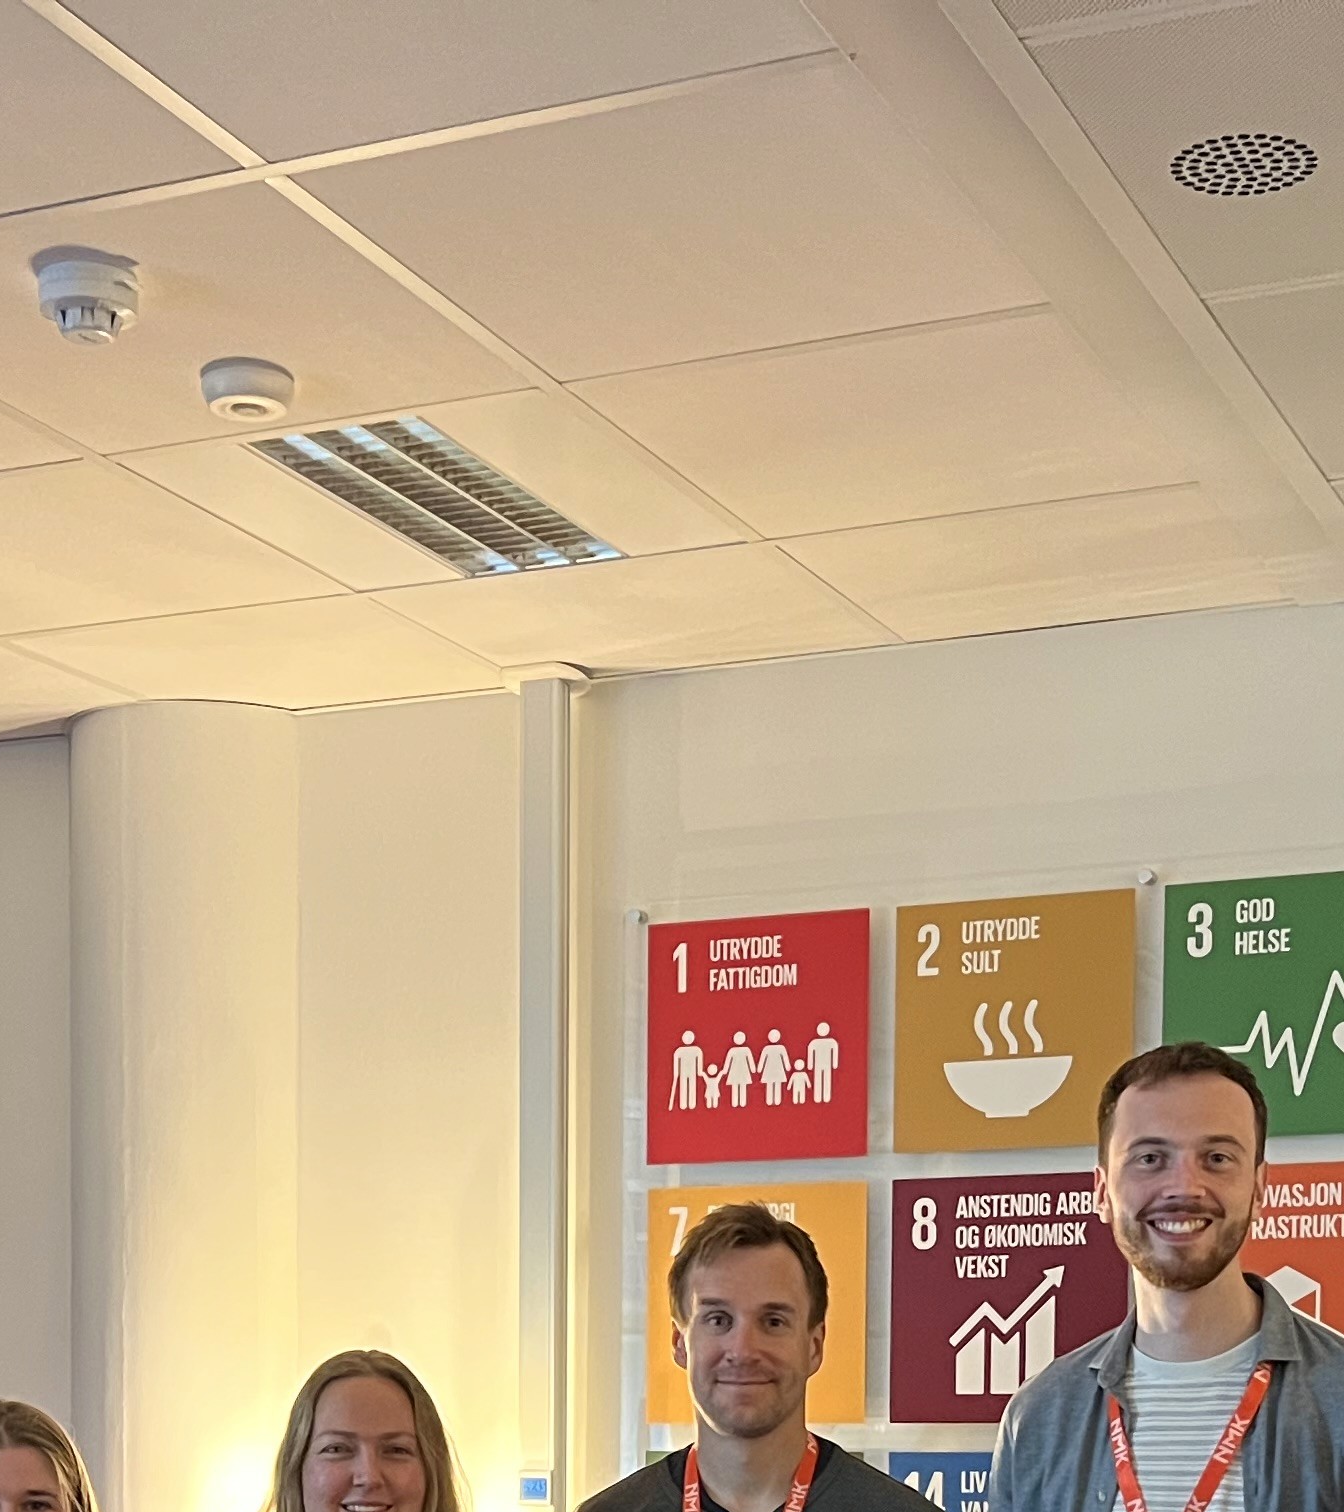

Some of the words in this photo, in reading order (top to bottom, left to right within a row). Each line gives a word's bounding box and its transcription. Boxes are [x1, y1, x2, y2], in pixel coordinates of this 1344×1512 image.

[1235, 897, 1275, 923] GOD
[961, 916, 1041, 945] UTRYDDE
[1186, 902, 1213, 957] 3
[1235, 928, 1291, 955] HELSE
[709, 934, 782, 962] UTRYDDE
[916, 924, 941, 977] 2
[960, 949, 1001, 975] SULT
[672, 942, 688, 993] 1
[709, 963, 797, 992] FATTIGDOM
[955, 1192, 1051, 1219] ANSTENDIG
[668, 1206, 688, 1257] 7
[911, 1197, 937, 1250] 8
[955, 1225, 980, 1249] OG
[983, 1222, 1087, 1248] ØKONOMISK
[955, 1254, 1009, 1279] VEKST
[1110, 1418, 1129, 1467] NMK
[1213, 1413, 1251, 1465] NMK
[961, 1471, 987, 1493] LIV
